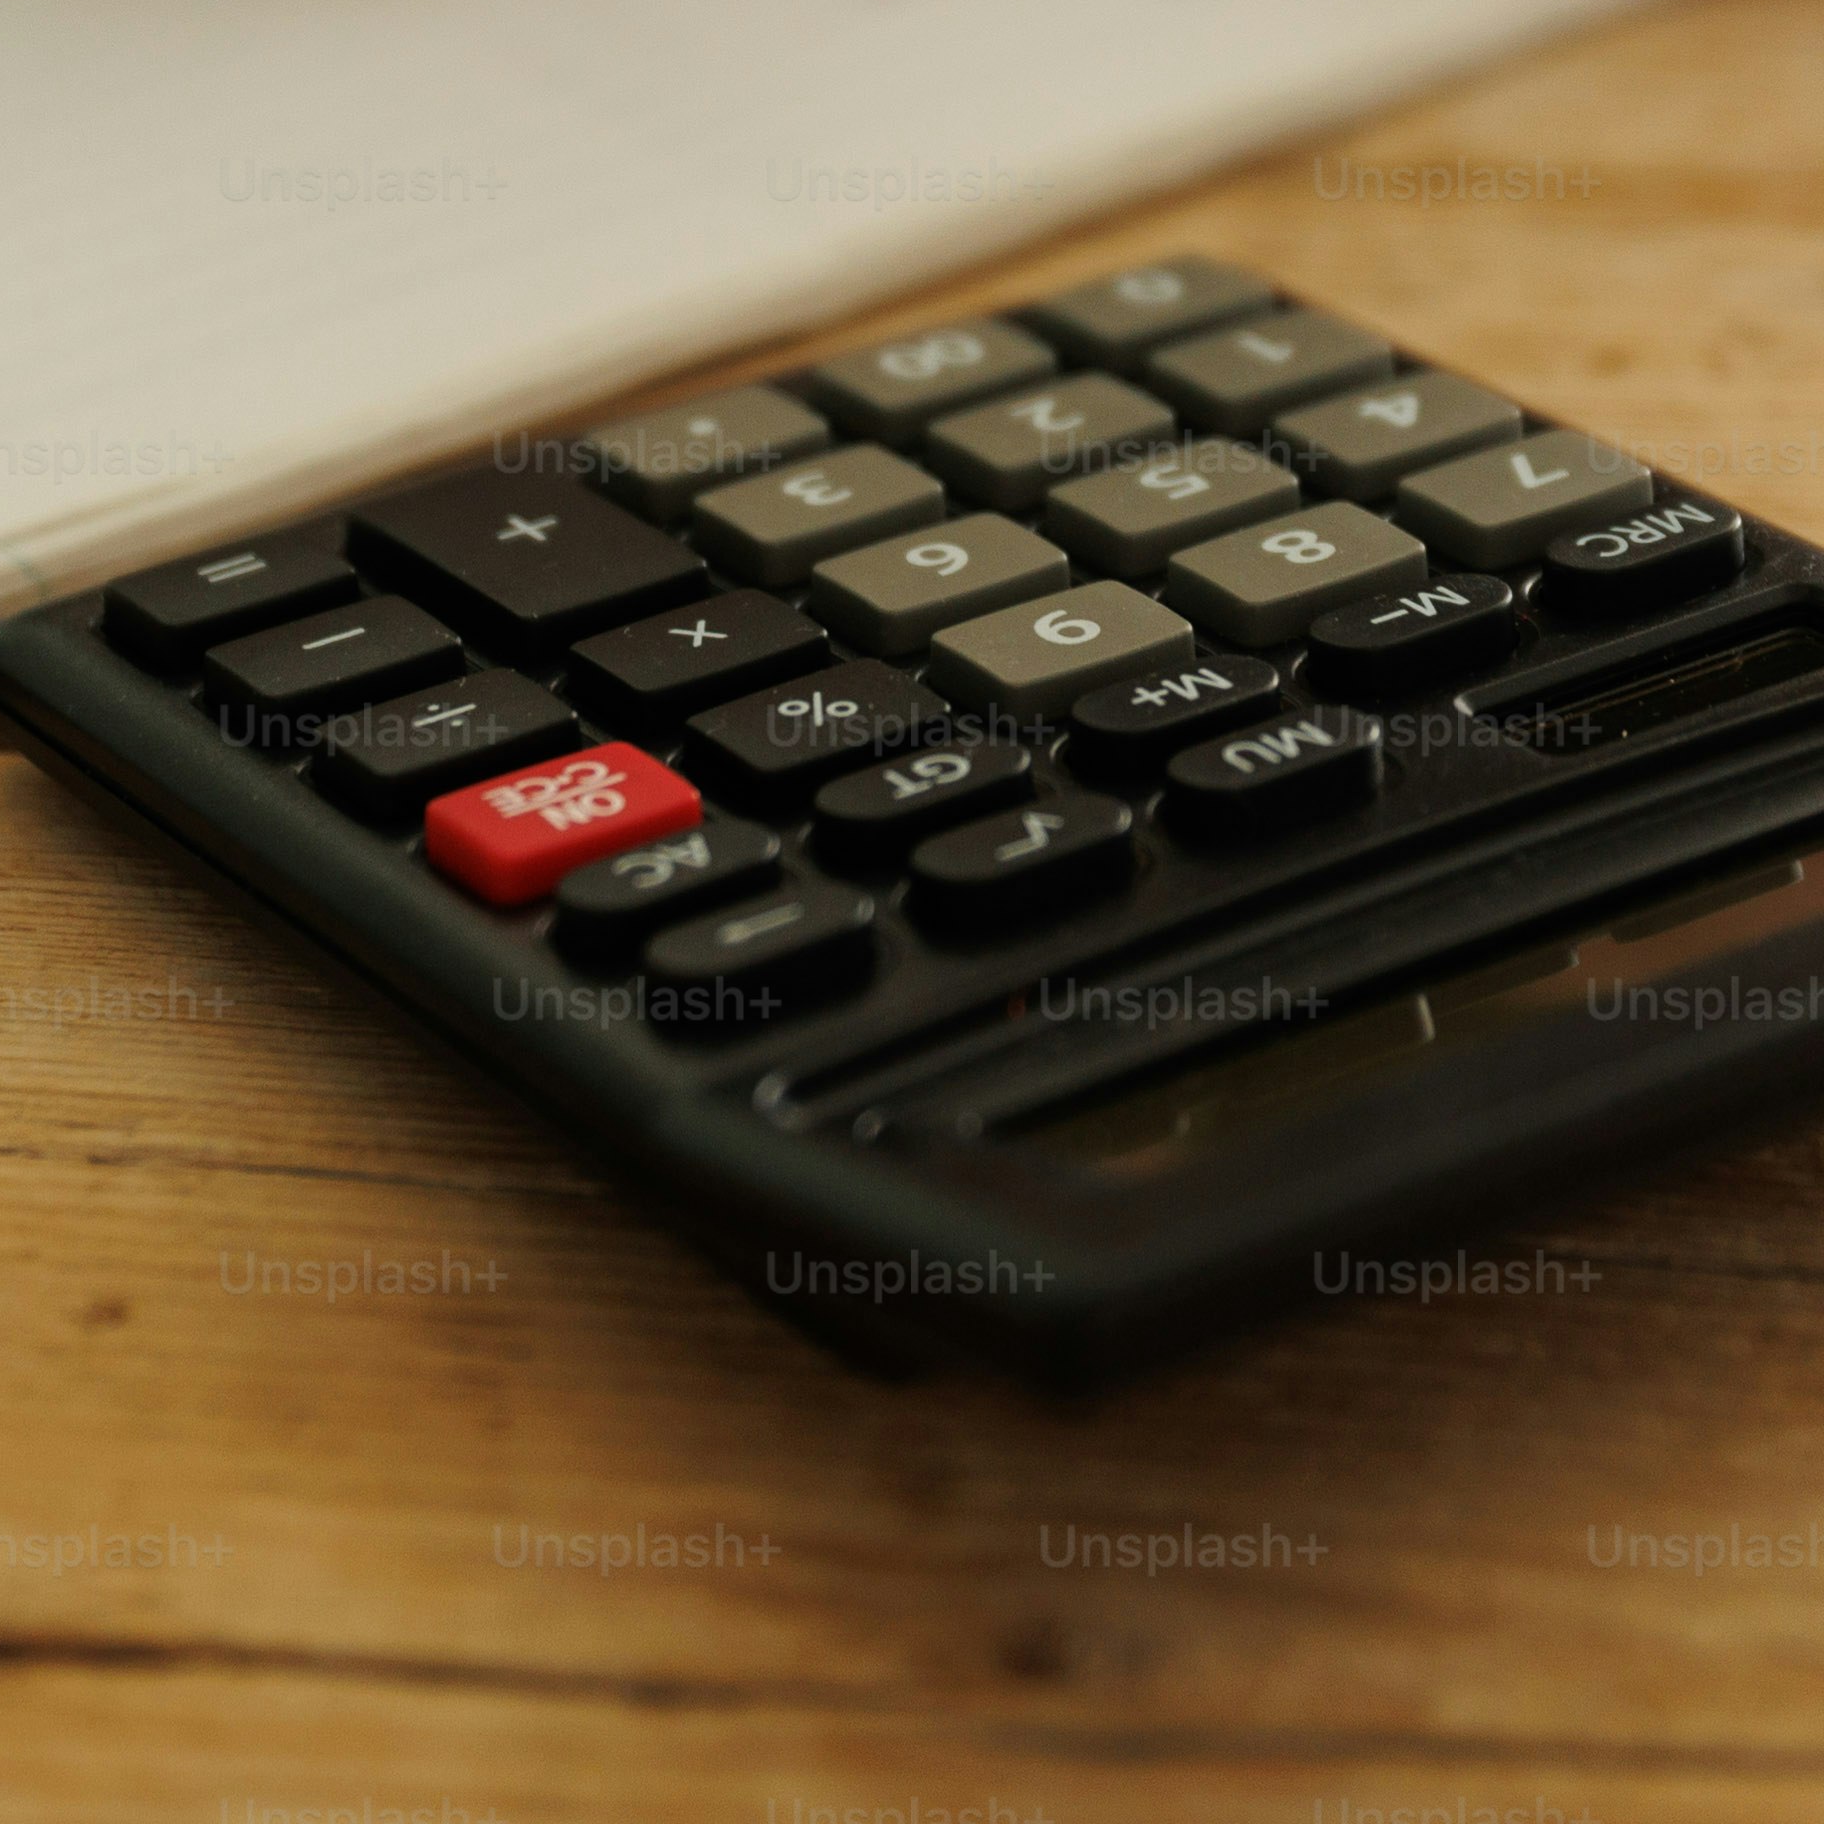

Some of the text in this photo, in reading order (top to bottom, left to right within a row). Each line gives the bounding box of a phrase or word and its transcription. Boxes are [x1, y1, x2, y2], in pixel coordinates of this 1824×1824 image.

[1236, 329, 1294, 363] 1
[1010, 398, 1085, 432] 2
[1357, 392, 1419, 428] 4
[1138, 462, 1211, 500] 5
[1510, 452, 1571, 490] 7
[782, 473, 853, 507] 3
[1261, 528, 1336, 565] 8
[1575, 502, 1717, 559] MRC
[904, 542, 970, 577] 6
[1032, 609, 1101, 645] 9
[1130, 666, 1234, 708] M+
[777, 690, 859, 727] %
[1220, 719, 1335, 774] MU
[881, 751, 972, 801] GT
[538, 788, 627, 832] ON
[611, 831, 712, 890] AC
